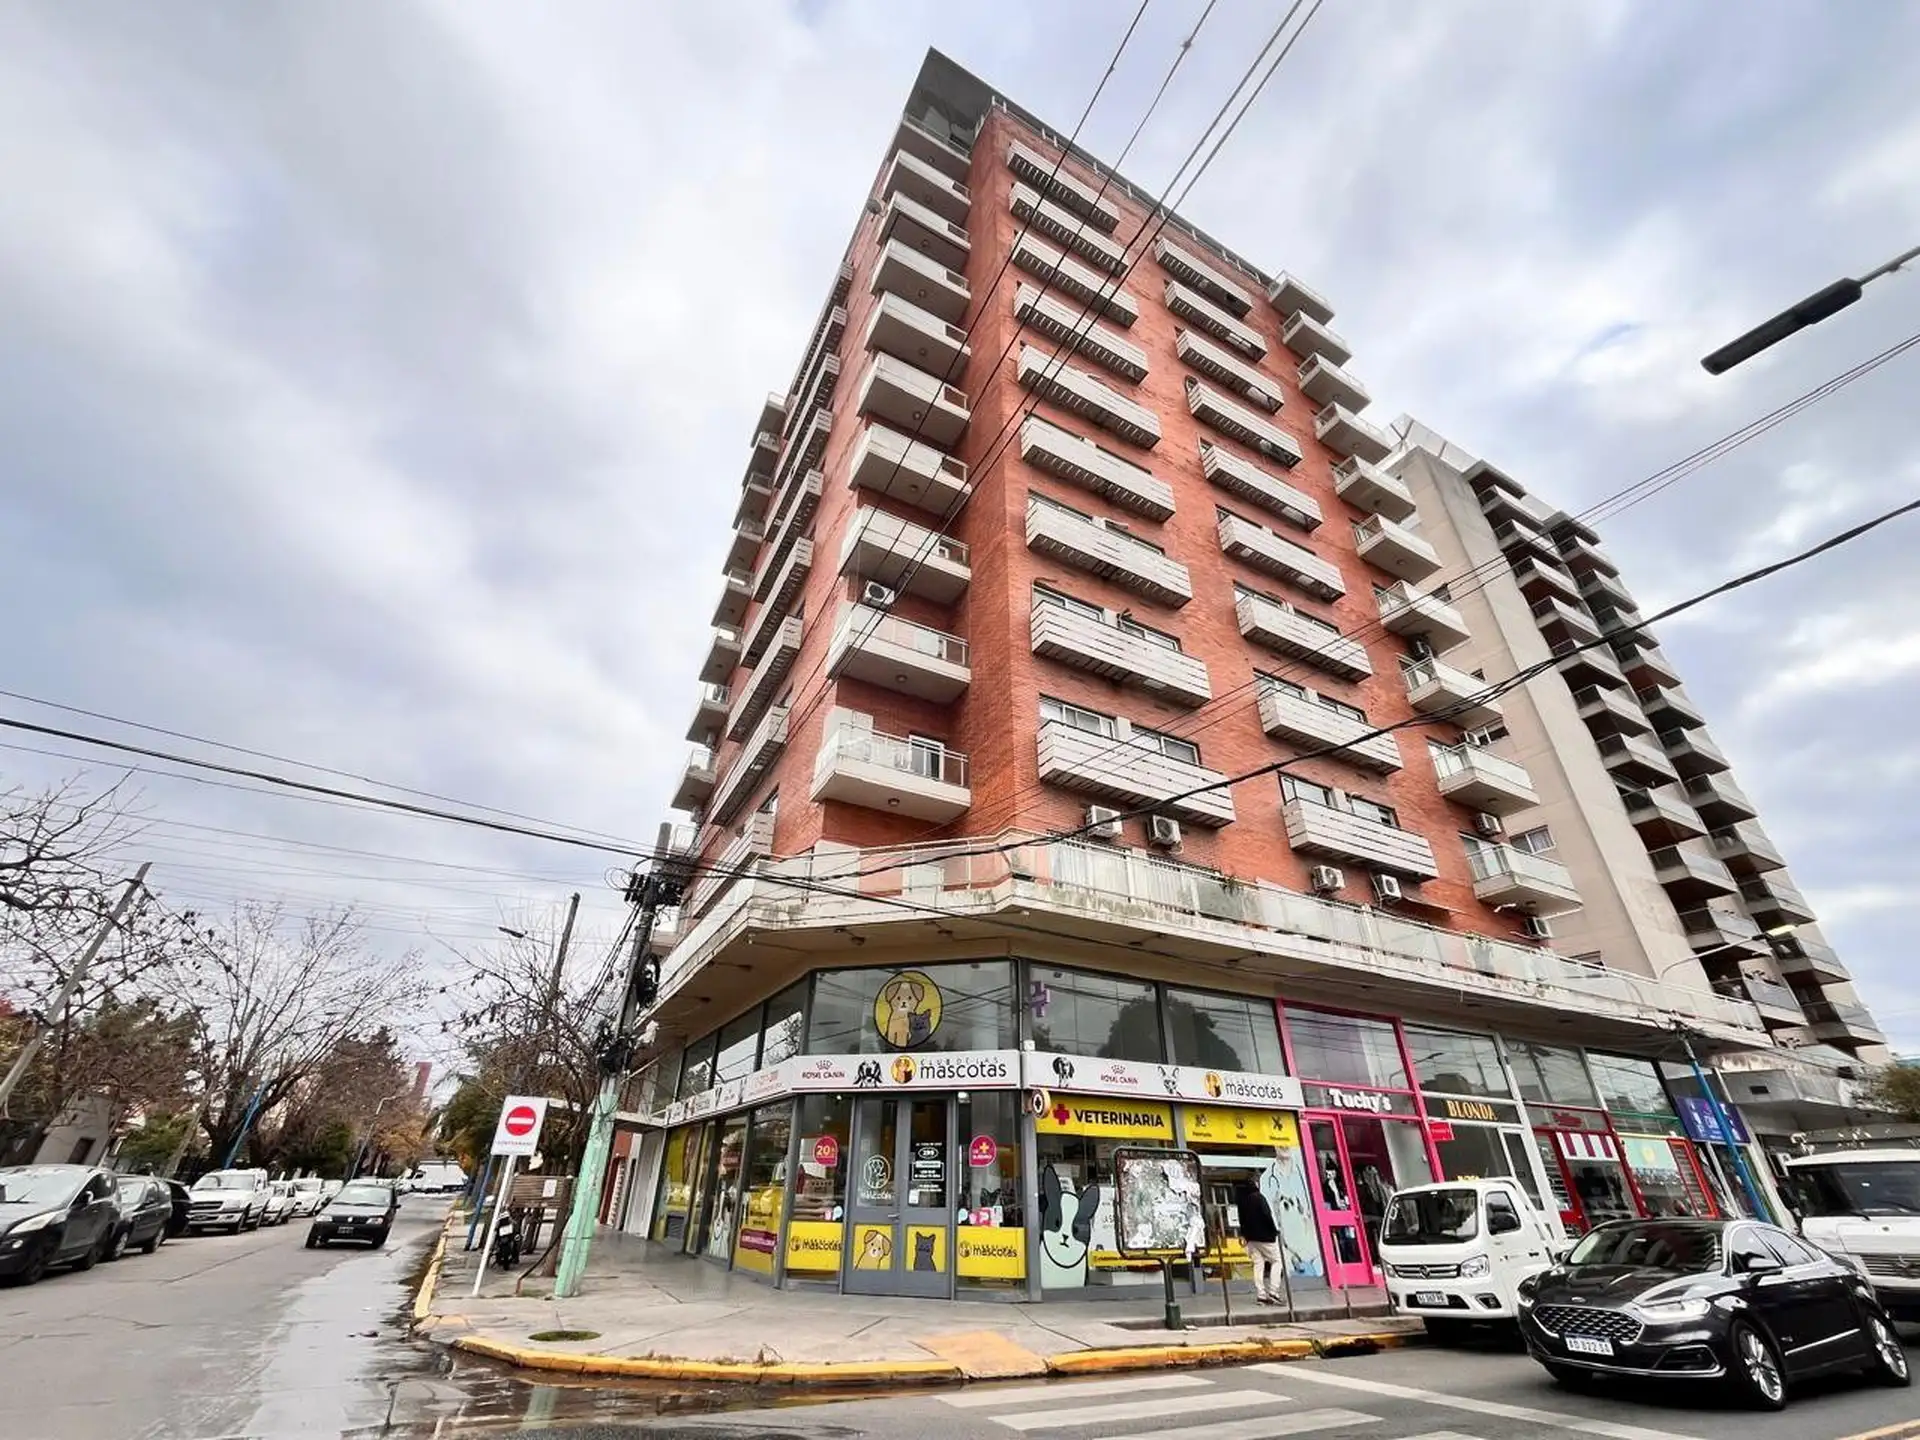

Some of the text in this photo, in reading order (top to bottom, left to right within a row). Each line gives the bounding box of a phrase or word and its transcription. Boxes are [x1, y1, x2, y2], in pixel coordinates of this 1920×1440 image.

[920, 1061, 1007, 1080] mascotas
[1225, 1081, 1284, 1100] mascotas
[1328, 1087, 1393, 1114] Tuchy's
[1074, 1109, 1165, 1127] VETERINARIA
[1446, 1100, 1498, 1121] BLONDA
[972, 1246, 1018, 1258] mascotas
